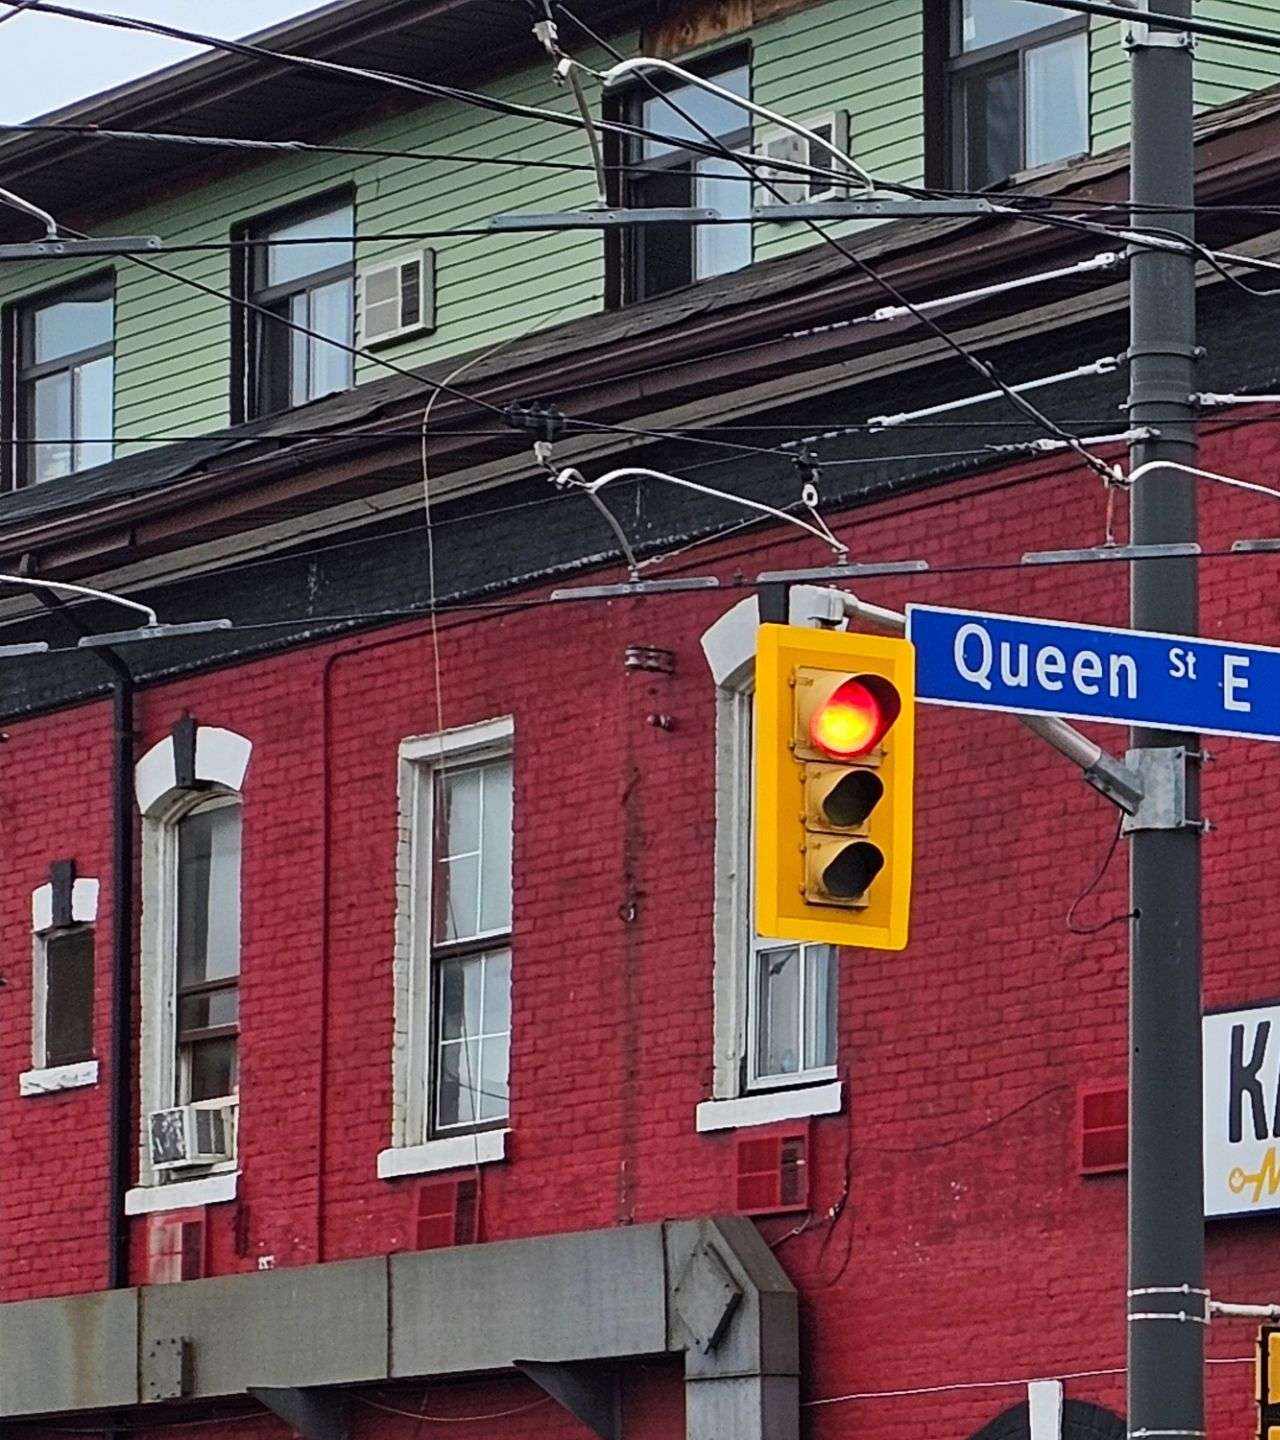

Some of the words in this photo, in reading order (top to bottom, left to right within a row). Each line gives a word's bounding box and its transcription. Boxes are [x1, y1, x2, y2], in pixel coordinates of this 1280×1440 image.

[953, 622, 1138, 699] Queen
[1168, 648, 1198, 681] St
[1223, 654, 1251, 713] E
